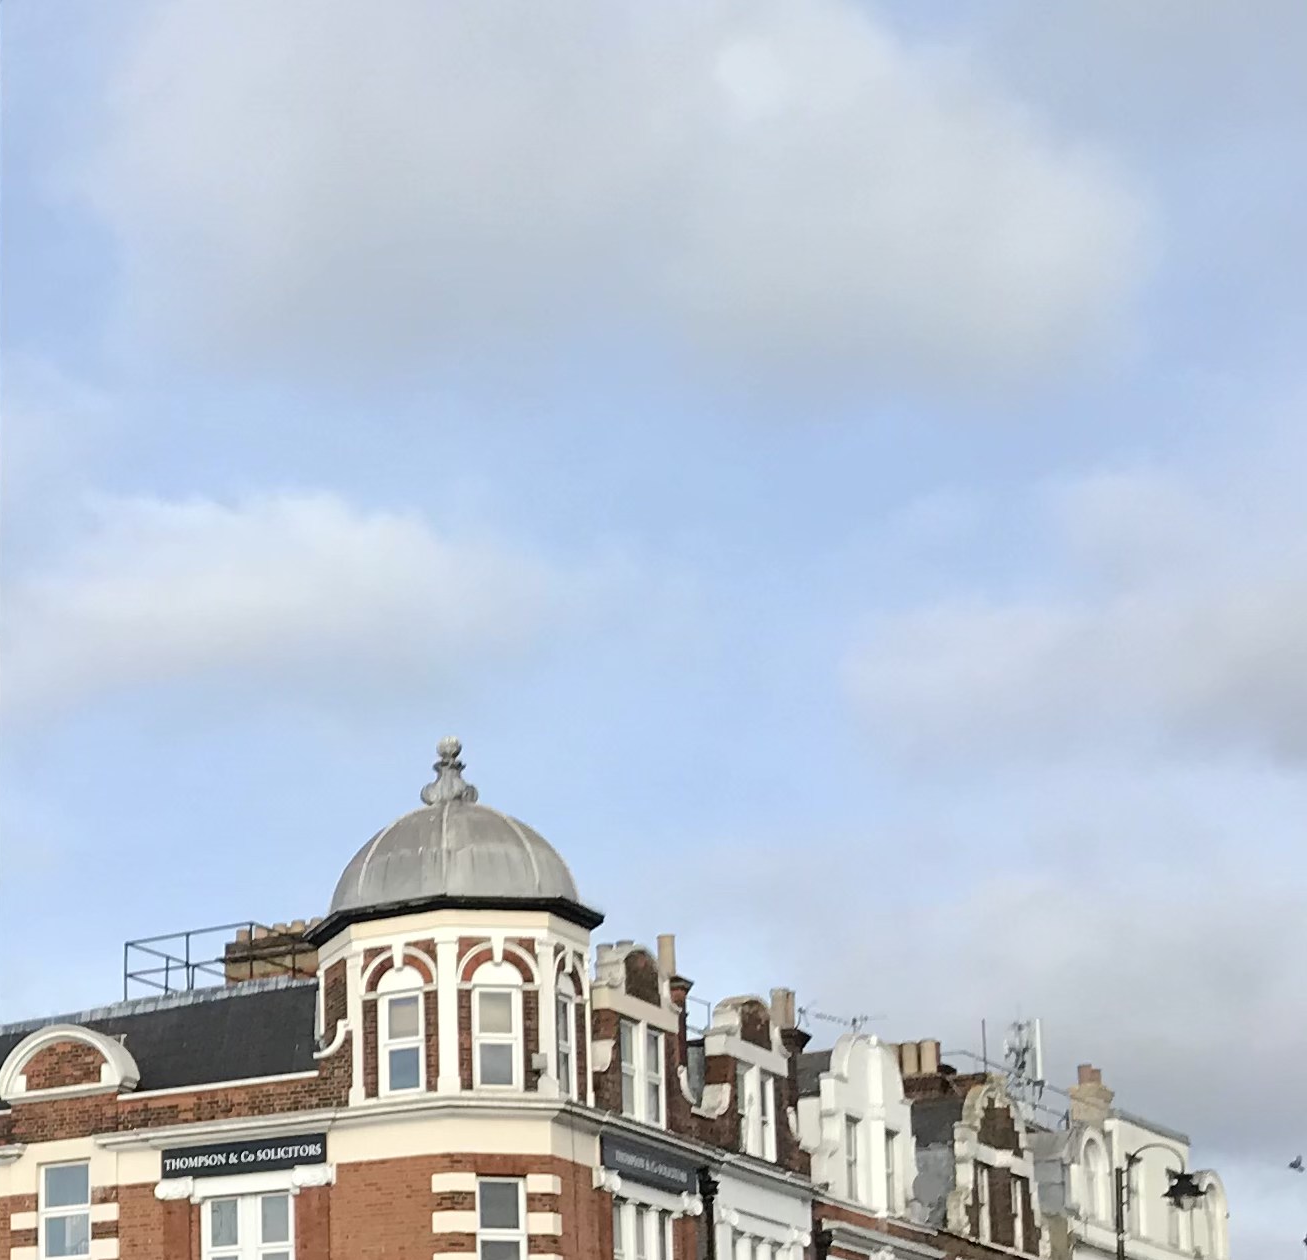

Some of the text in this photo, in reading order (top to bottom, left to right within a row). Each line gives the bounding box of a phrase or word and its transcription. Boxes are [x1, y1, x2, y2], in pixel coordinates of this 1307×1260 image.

[164, 1143, 322, 1171] THOMPSON & Co SOLICITORS
